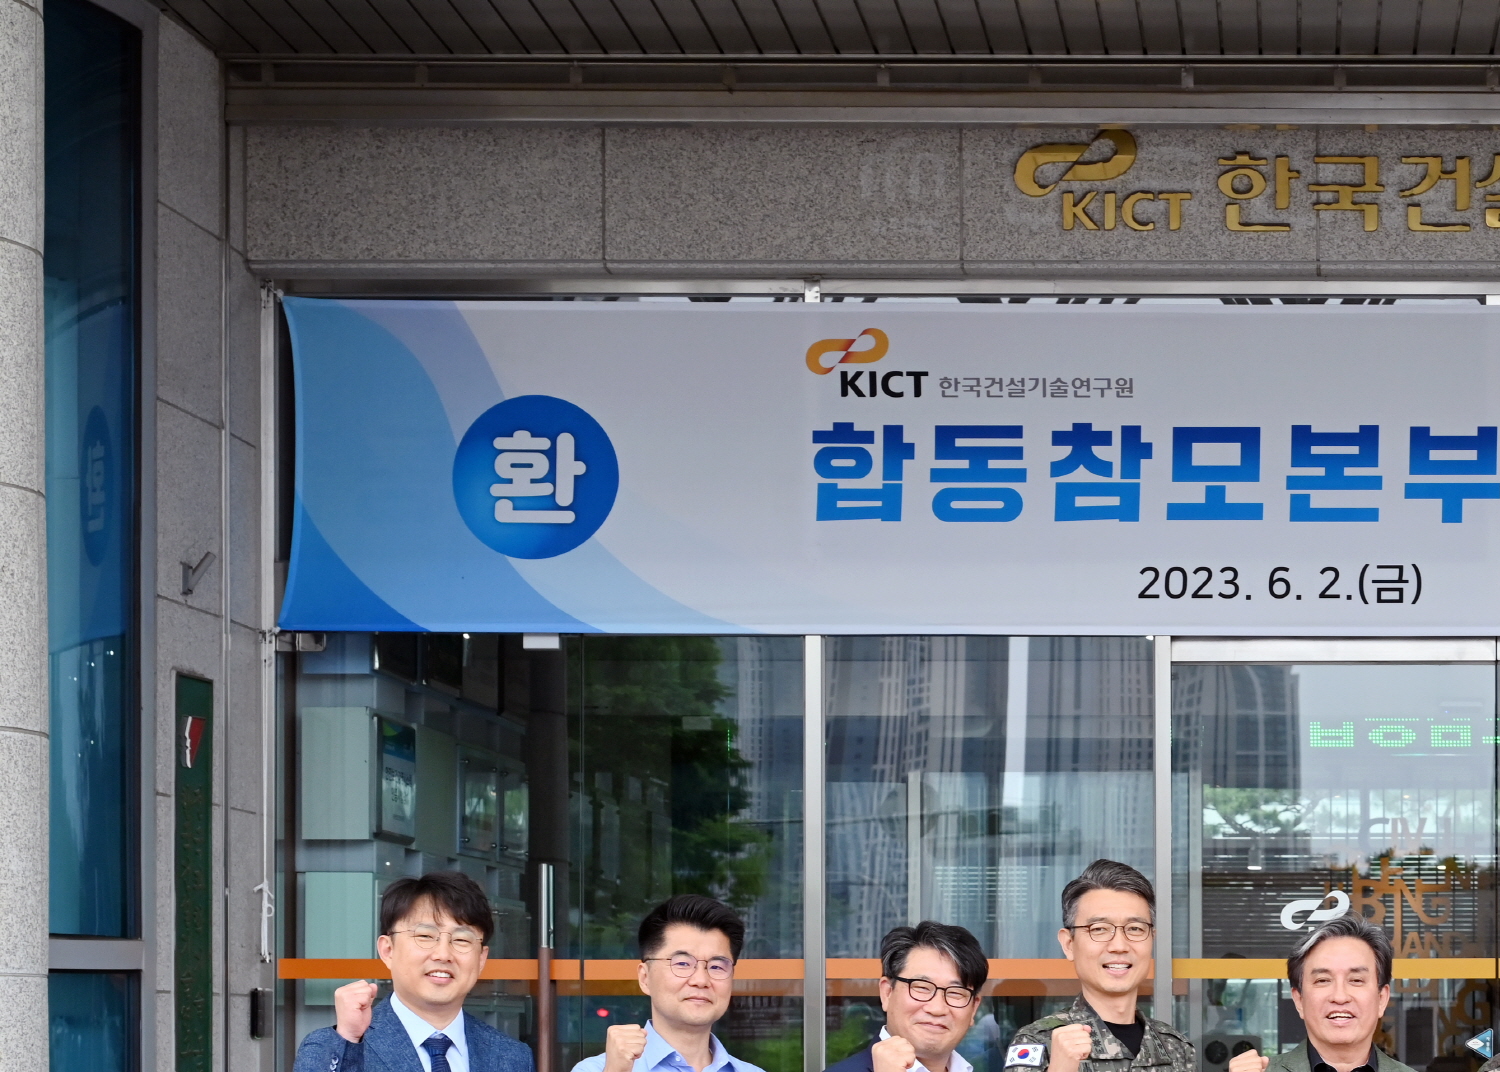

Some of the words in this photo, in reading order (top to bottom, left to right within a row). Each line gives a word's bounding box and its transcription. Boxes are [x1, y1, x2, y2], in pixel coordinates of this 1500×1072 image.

[1062, 191, 1192, 232] KICT
[841, 371, 928, 398] KICT
[939, 377, 1134, 399] 한국건설기술연구원
[492, 430, 585, 524] 환
[813, 422, 1500, 523] 합동참모본부
[1138, 566, 1252, 600] 2023.
[1268, 566, 1301, 600] 6.
[1319, 563, 1422, 605] 2.(금)
